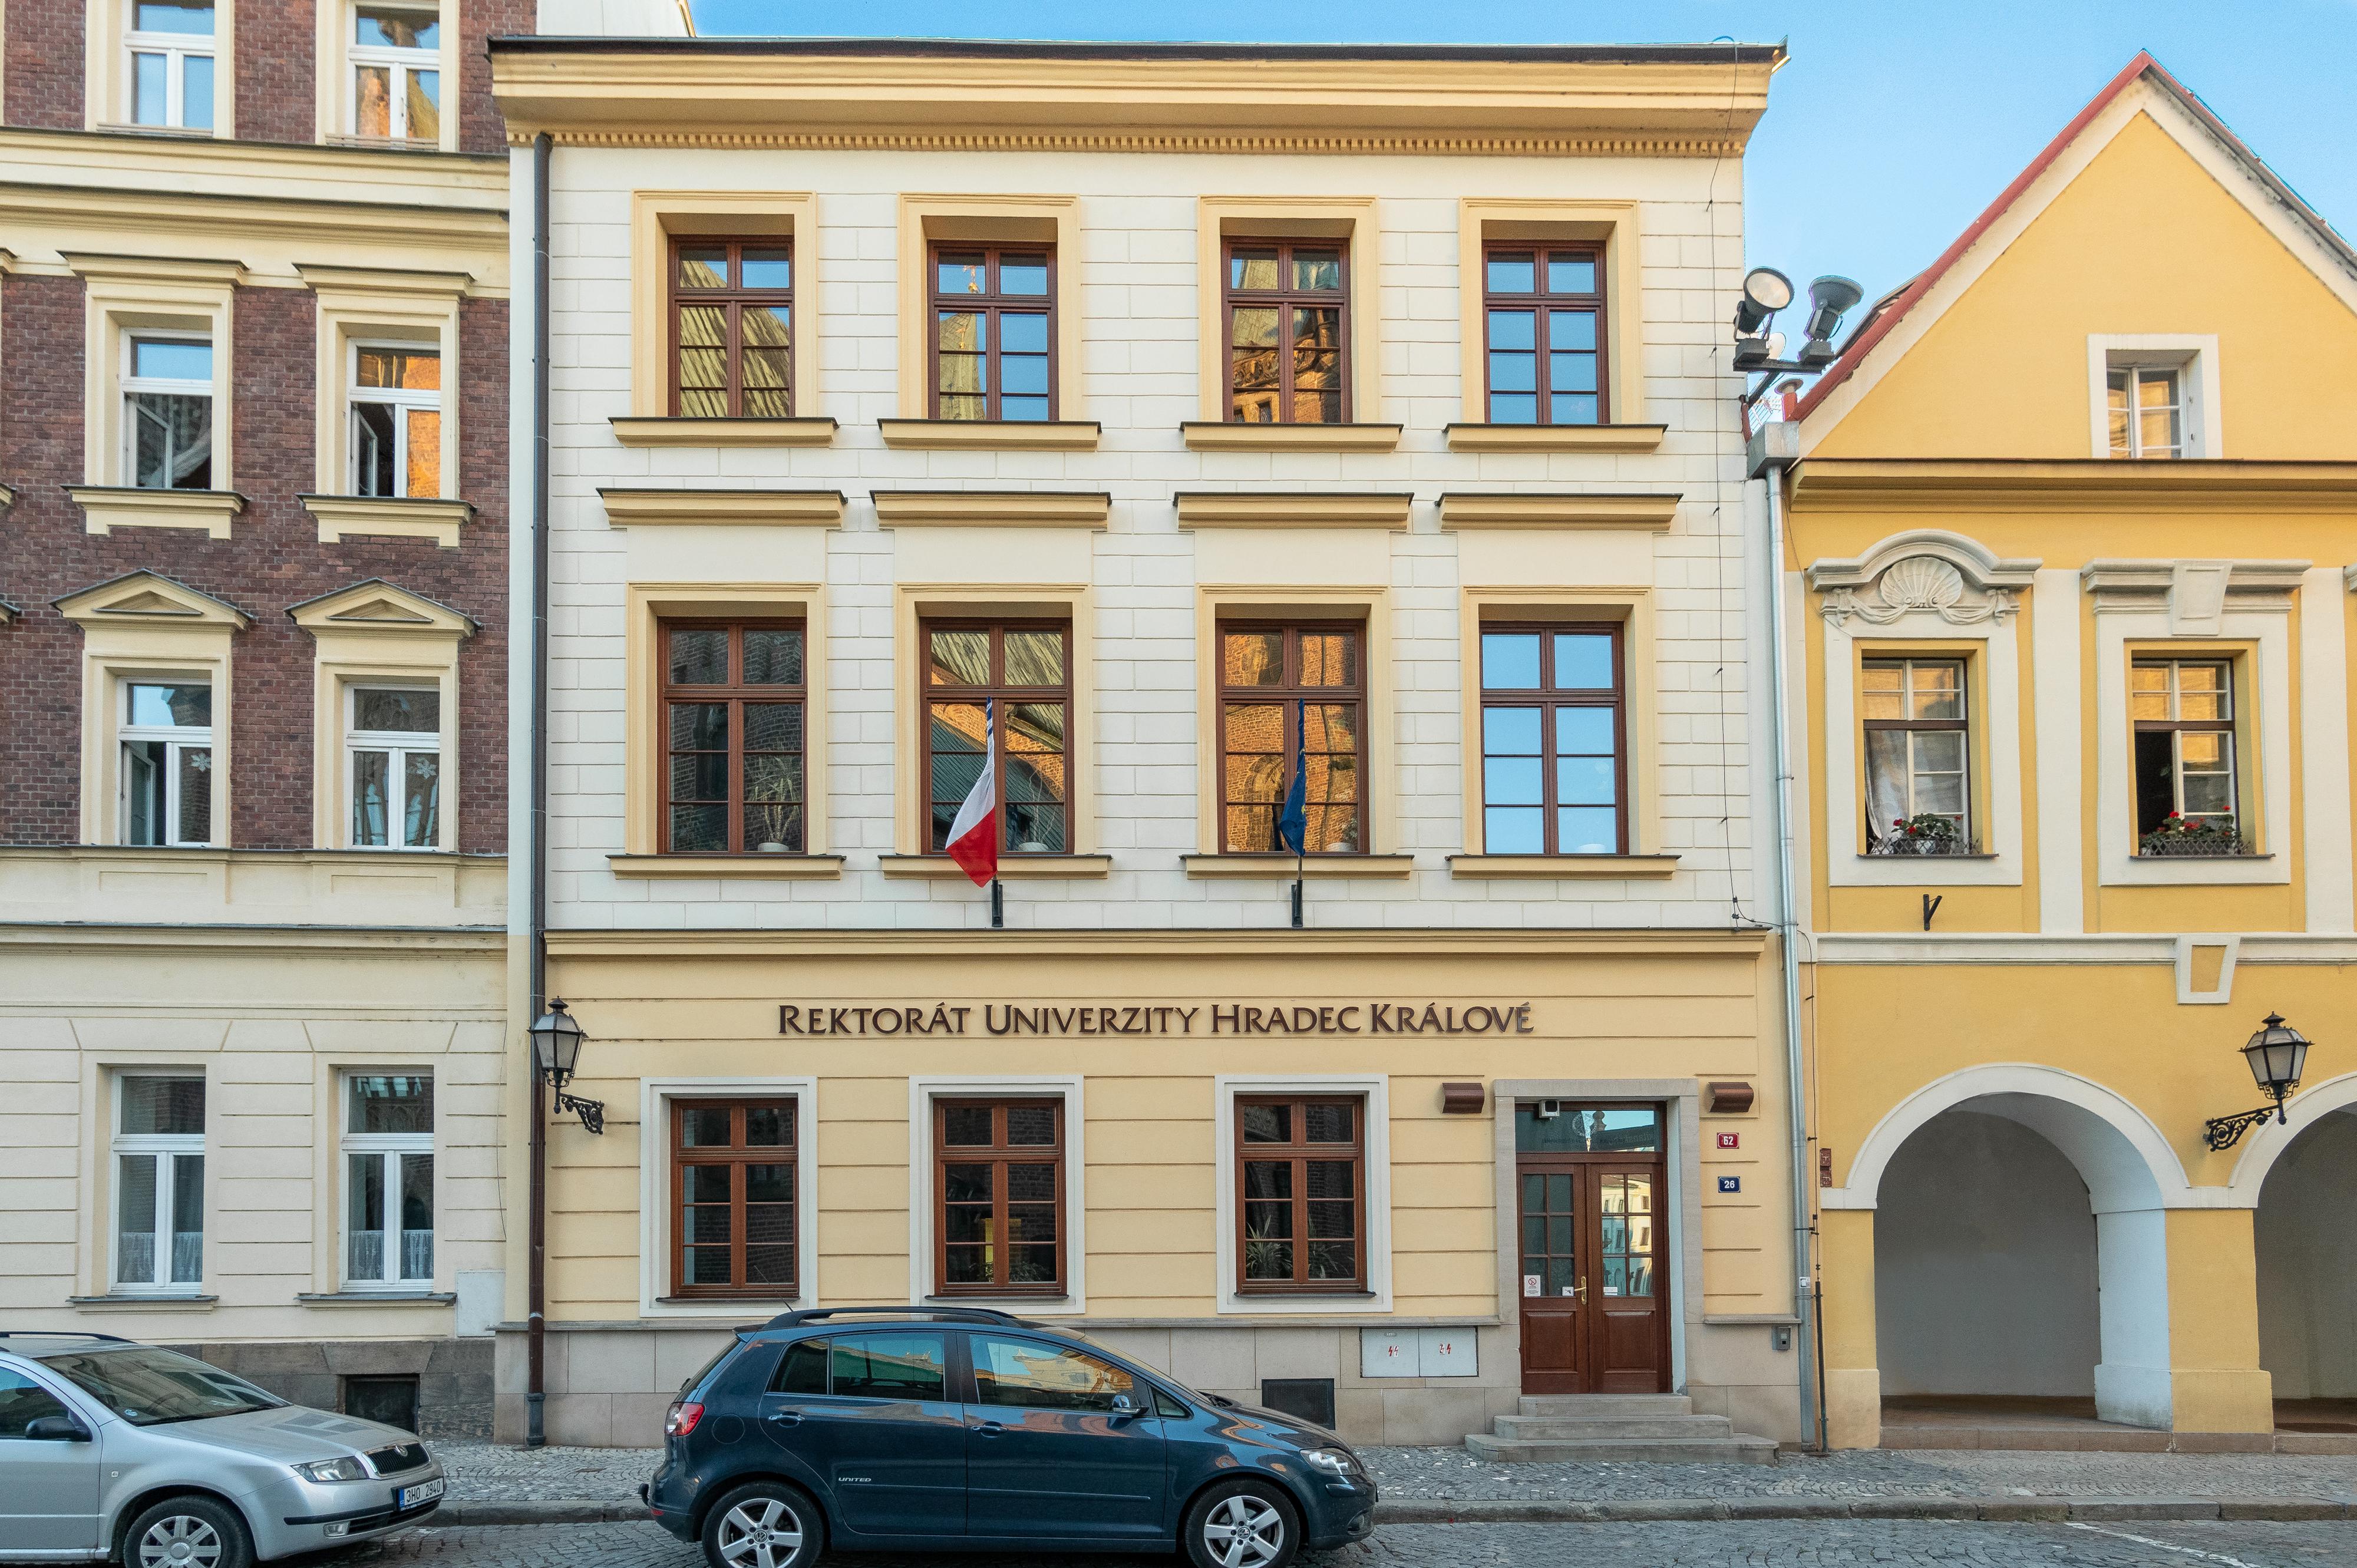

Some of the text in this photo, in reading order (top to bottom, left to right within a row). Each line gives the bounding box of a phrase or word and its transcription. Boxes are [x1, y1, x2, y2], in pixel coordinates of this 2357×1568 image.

[778, 1002, 1534, 1034] REKTORÁT UNIVERZITY HRADEC KRÁLOVÉ
[1724, 1136, 1734, 1145] 62
[1724, 1180, 1735, 1189] 26
[425, 1481, 440, 1497] 2940
